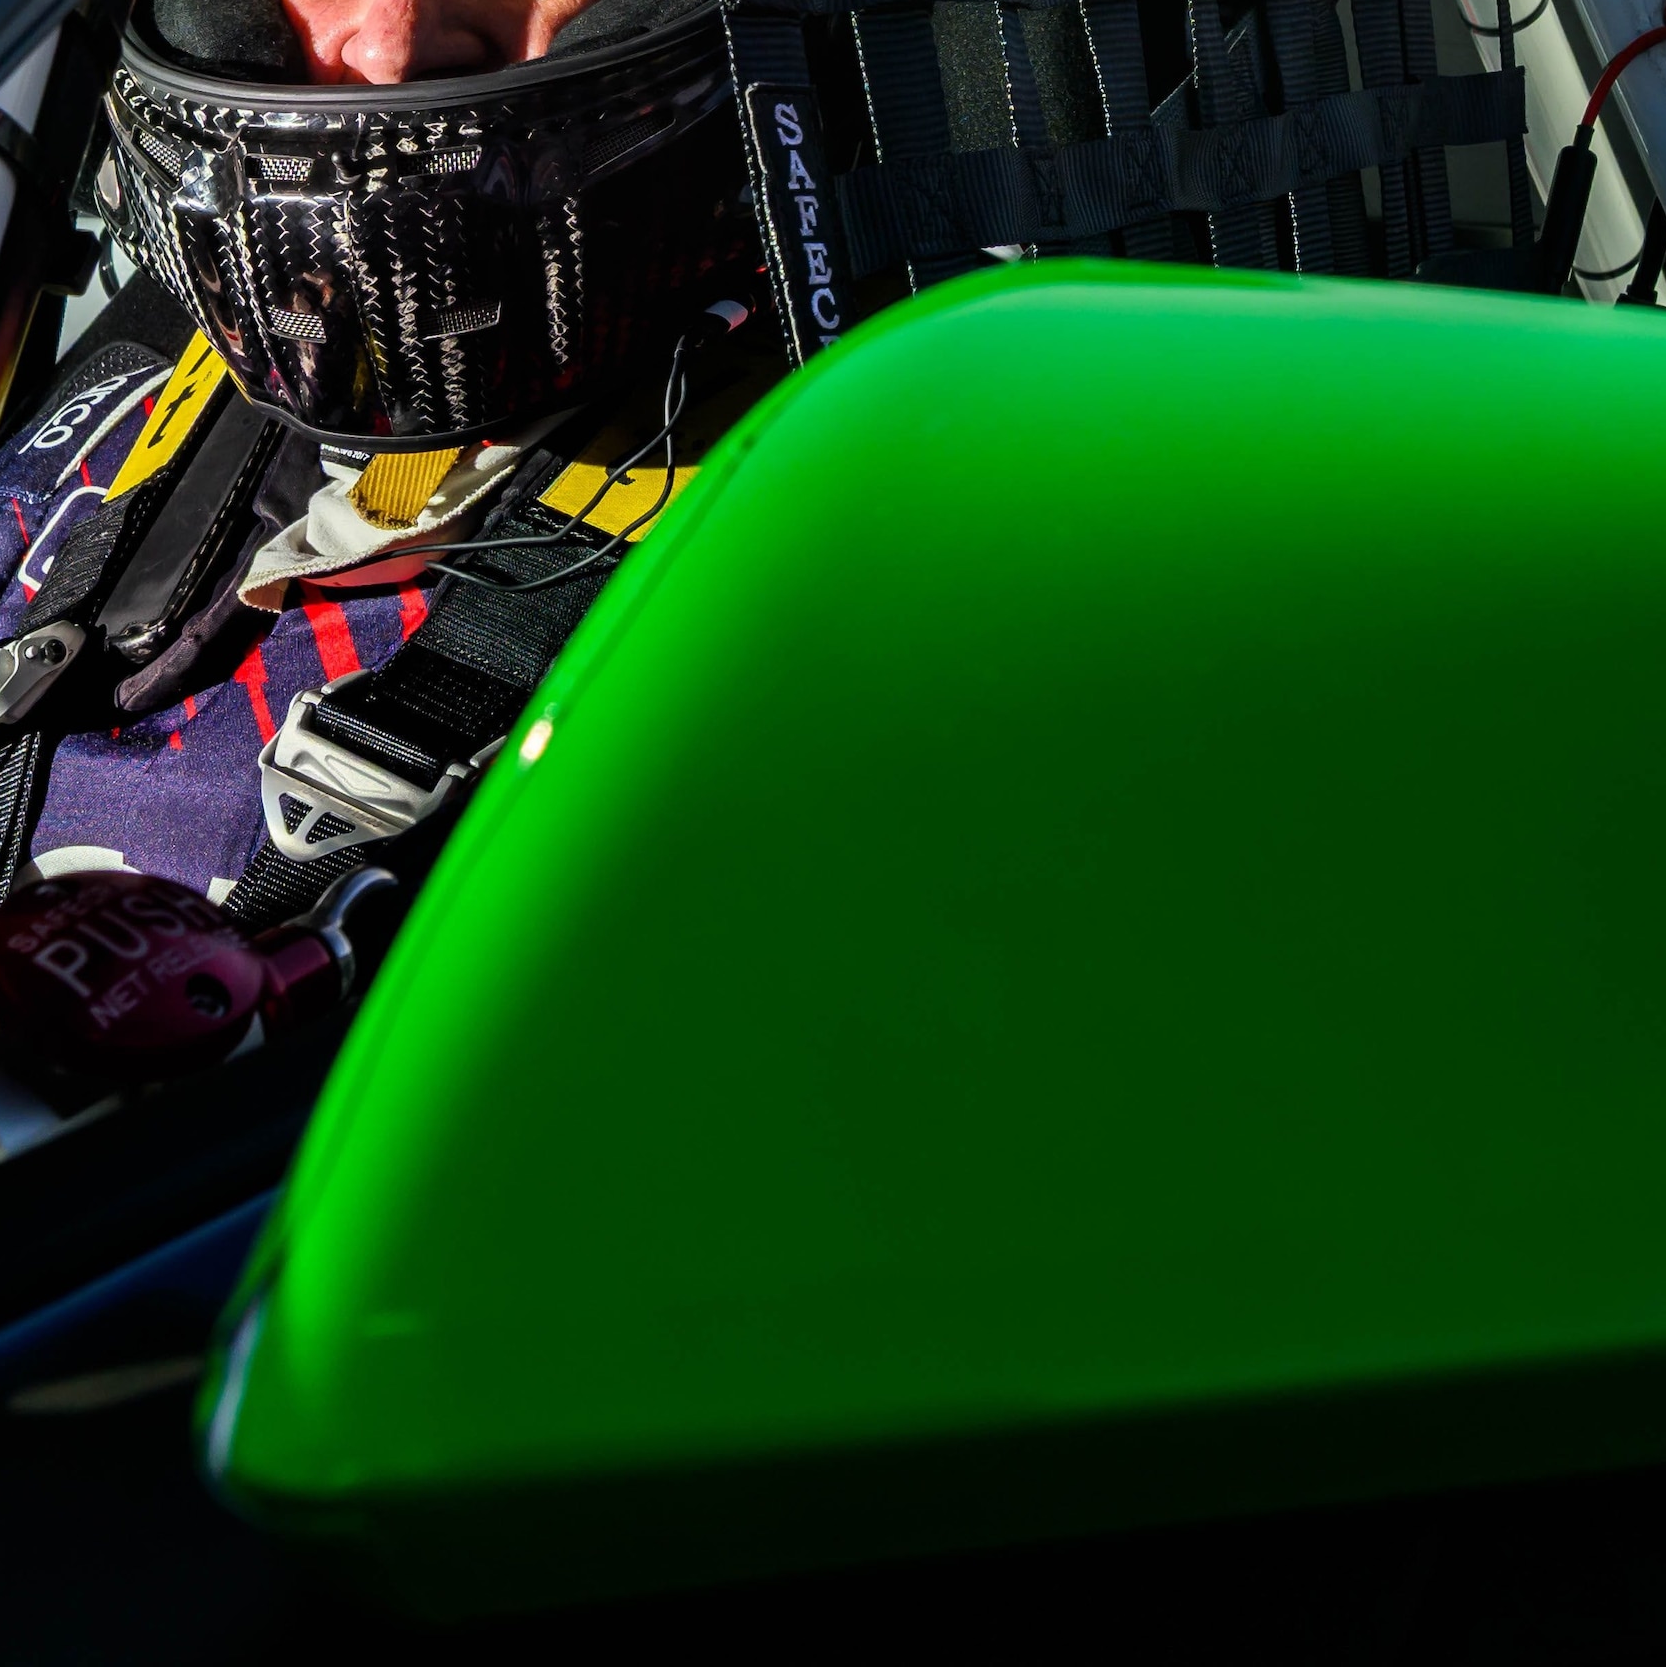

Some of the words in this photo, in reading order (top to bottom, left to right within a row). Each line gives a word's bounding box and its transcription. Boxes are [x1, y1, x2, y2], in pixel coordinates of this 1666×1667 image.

[773, 102, 842, 349] SAFEC
[32, 884, 225, 999] PUSH
[88, 968, 151, 1031] NET
